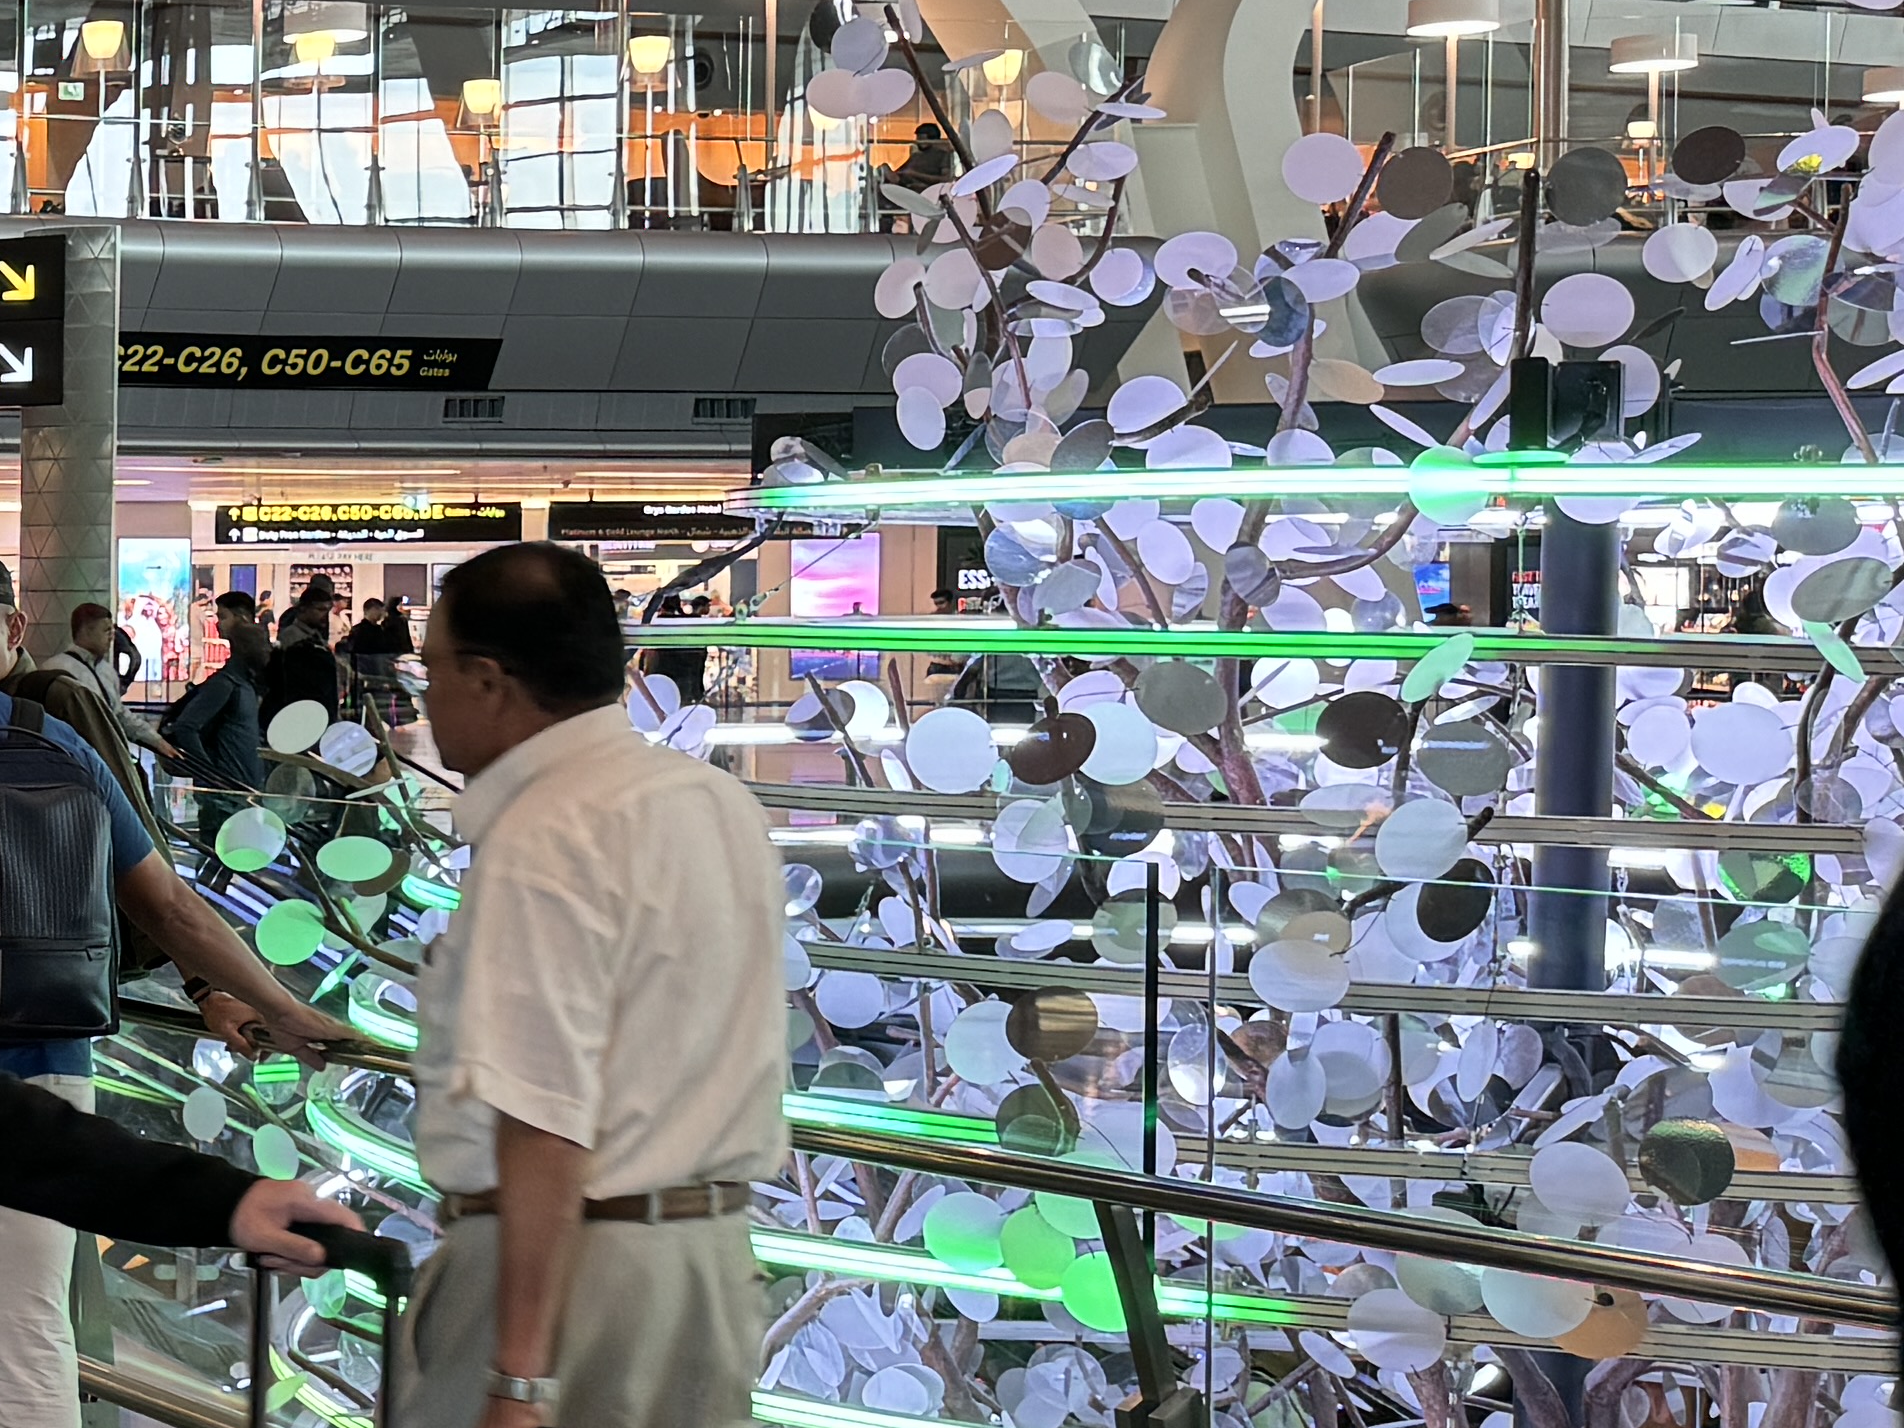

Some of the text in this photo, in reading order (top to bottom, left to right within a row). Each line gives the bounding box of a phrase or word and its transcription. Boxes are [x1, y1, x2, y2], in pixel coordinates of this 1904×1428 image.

[118, 345, 412, 380] 22-C26, C50-C65
[420, 367, 449, 376] Gates
